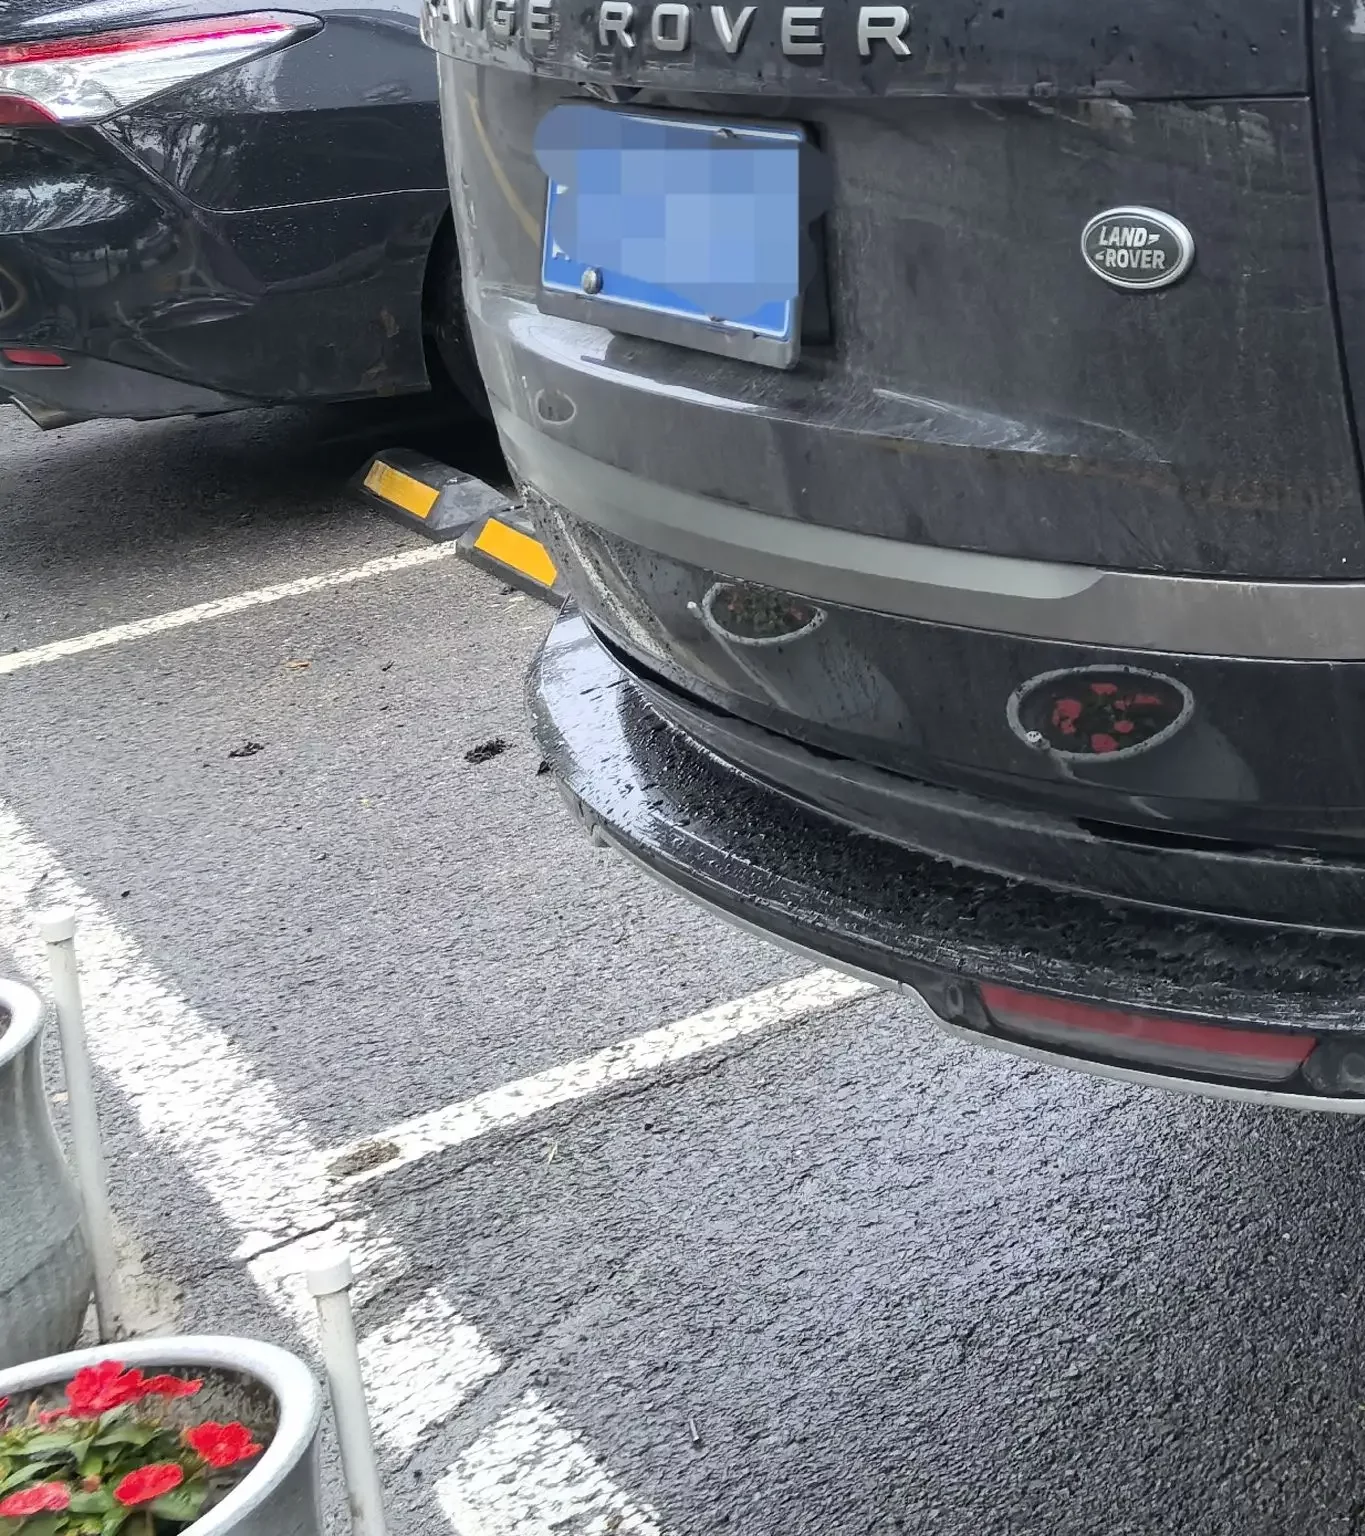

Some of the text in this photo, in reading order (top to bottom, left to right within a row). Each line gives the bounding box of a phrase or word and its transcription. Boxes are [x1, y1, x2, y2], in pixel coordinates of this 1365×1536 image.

[599, 0, 912, 56] ROVER
[1099, 225, 1148, 248] LAND
[1105, 248, 1166, 270] ROVER
